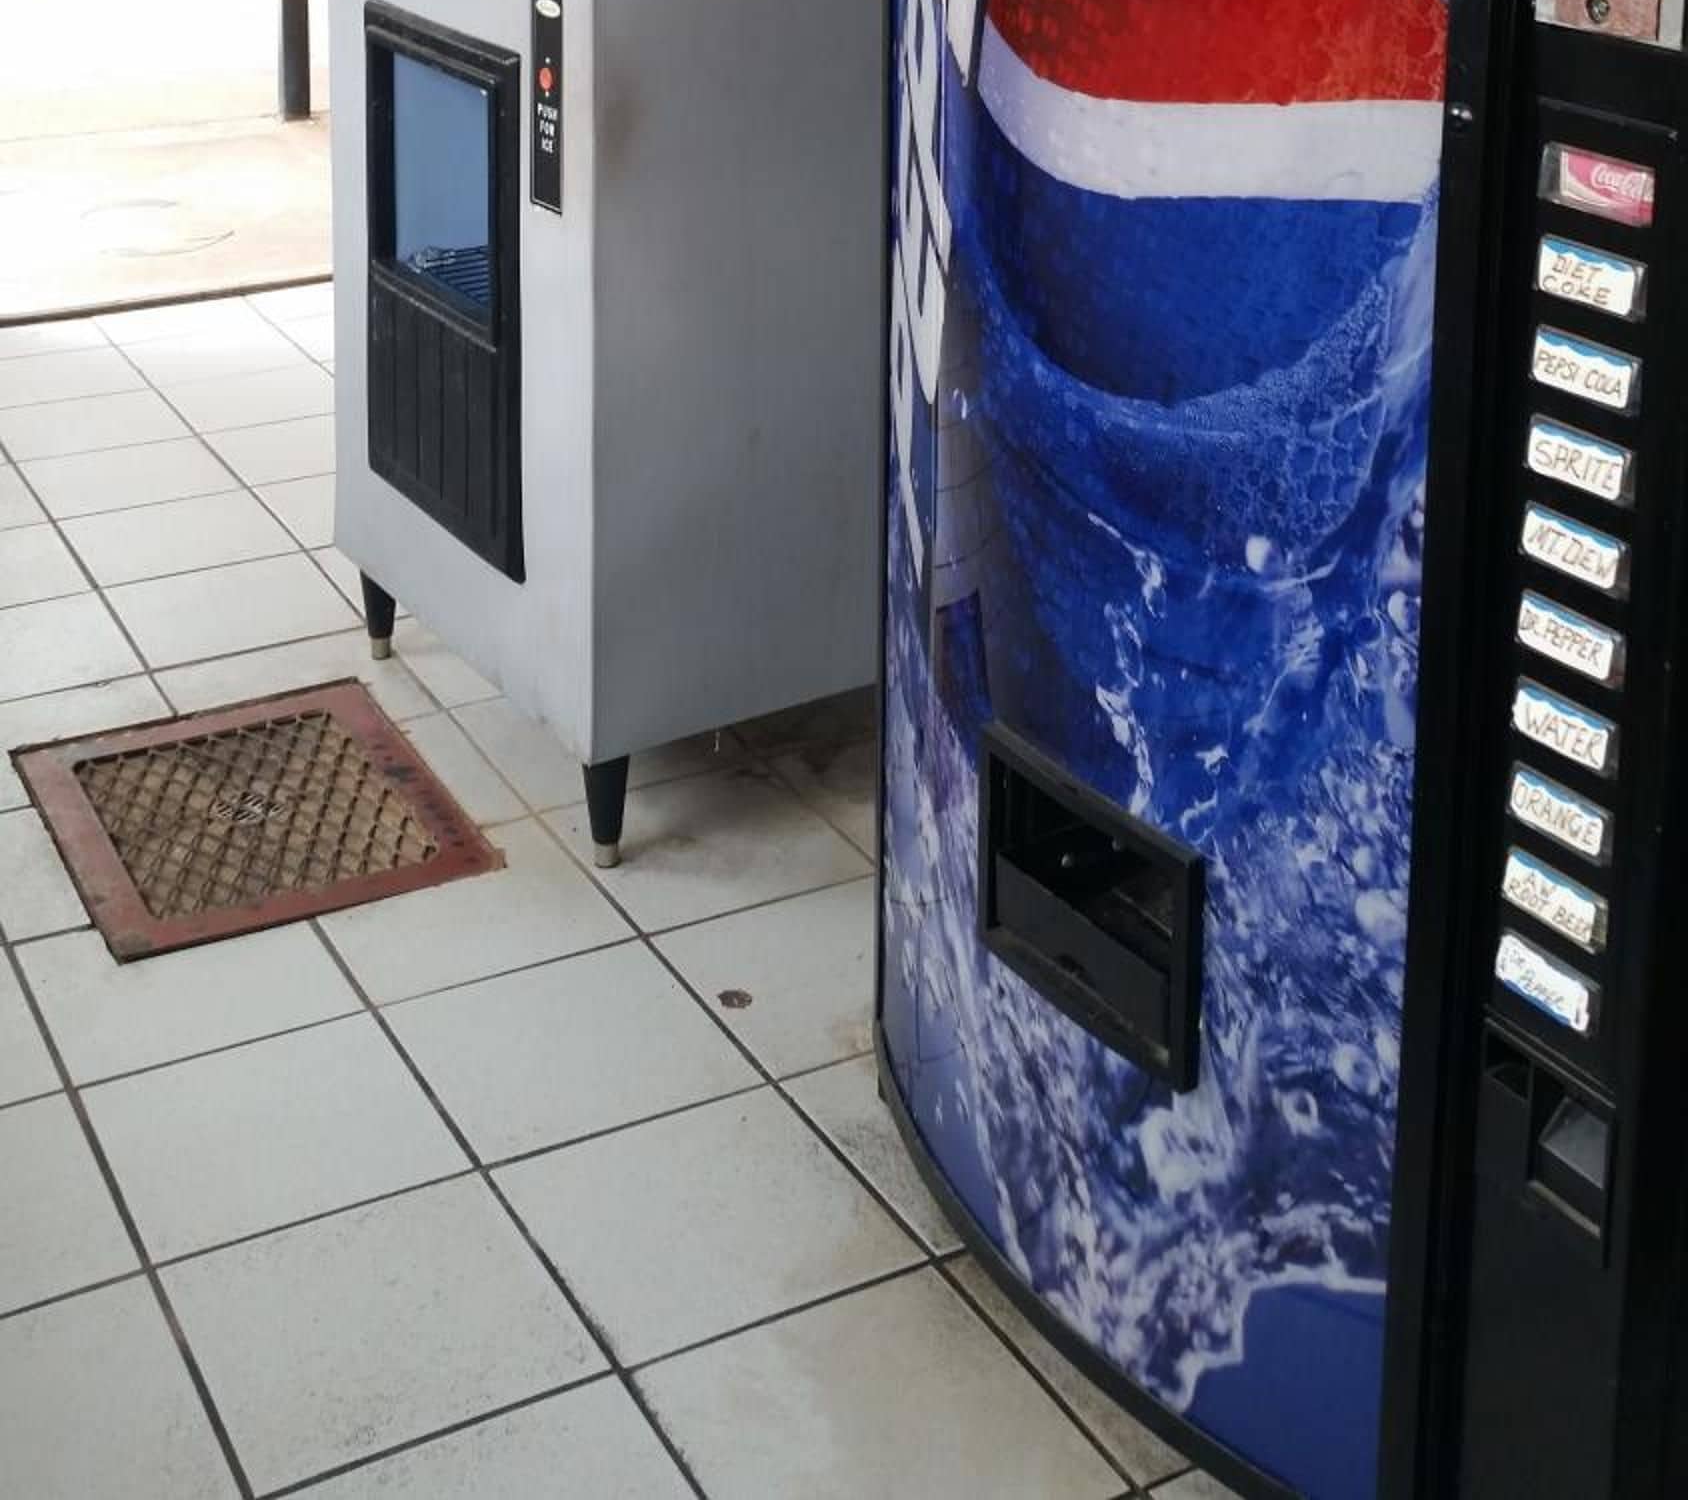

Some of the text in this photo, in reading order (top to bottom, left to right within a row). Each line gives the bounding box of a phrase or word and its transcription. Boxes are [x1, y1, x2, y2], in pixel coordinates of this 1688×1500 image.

[537, 103, 558, 121] PUSH
[539, 119, 555, 137] FOR
[541, 137, 553, 153] ICE
[1552, 255, 1602, 282] DIET
[1543, 275, 1611, 306] COKE
[1536, 349, 1622, 399] PEPSI COLA
[1535, 439, 1624, 491] SPRITE
[1525, 702, 1602, 767] WATER
[1512, 781, 1600, 847] ORANGE
